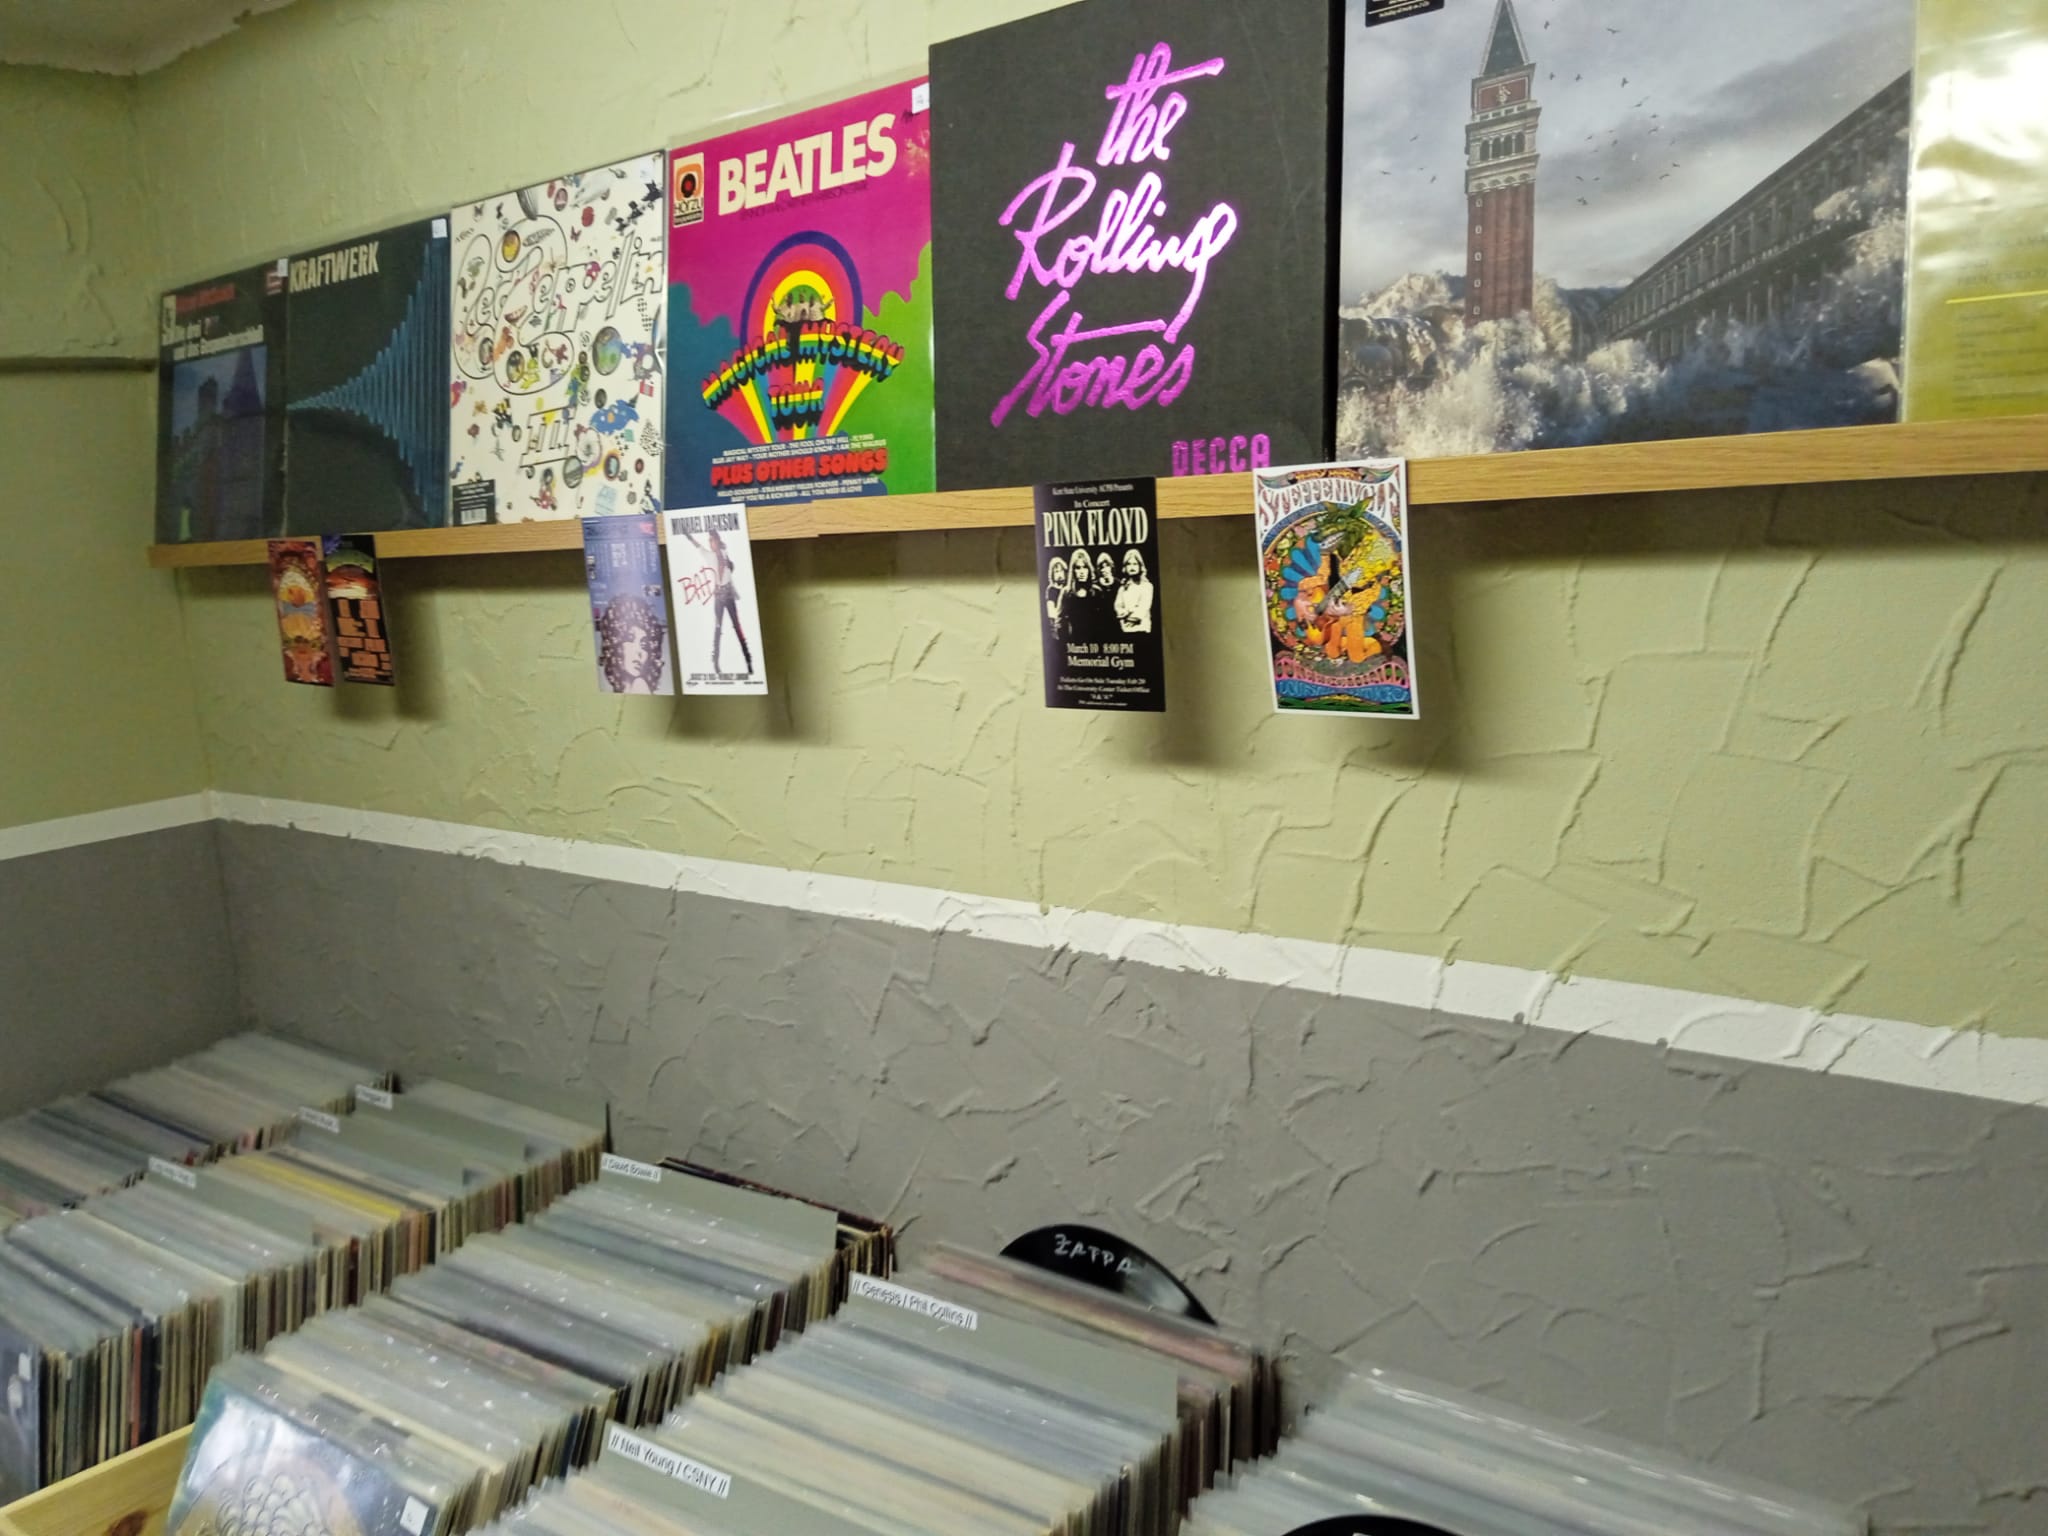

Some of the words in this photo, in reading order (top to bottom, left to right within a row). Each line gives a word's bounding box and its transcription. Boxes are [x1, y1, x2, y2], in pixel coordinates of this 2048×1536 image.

[1096, 41, 1224, 166] the
[719, 113, 897, 216] BEATLES
[289, 241, 380, 293] KRAFTWERK
[998, 141, 1237, 344] Rolling
[799, 320, 905, 380] MYSTERY
[990, 289, 1195, 428] Stones
[769, 378, 824, 425] TOUR
[711, 462, 753, 487] PLUS
[756, 456, 816, 482] OTHER
[818, 448, 888, 476] SONGS
[1172, 433, 1271, 477] DECCA
[671, 515, 703, 535] MICHAEL
[704, 513, 740, 533] JACKSON
[1042, 510, 1085, 547] PINK
[1086, 506, 1149, 546] FLOYD
[1111, 656, 1135, 670] Gym
